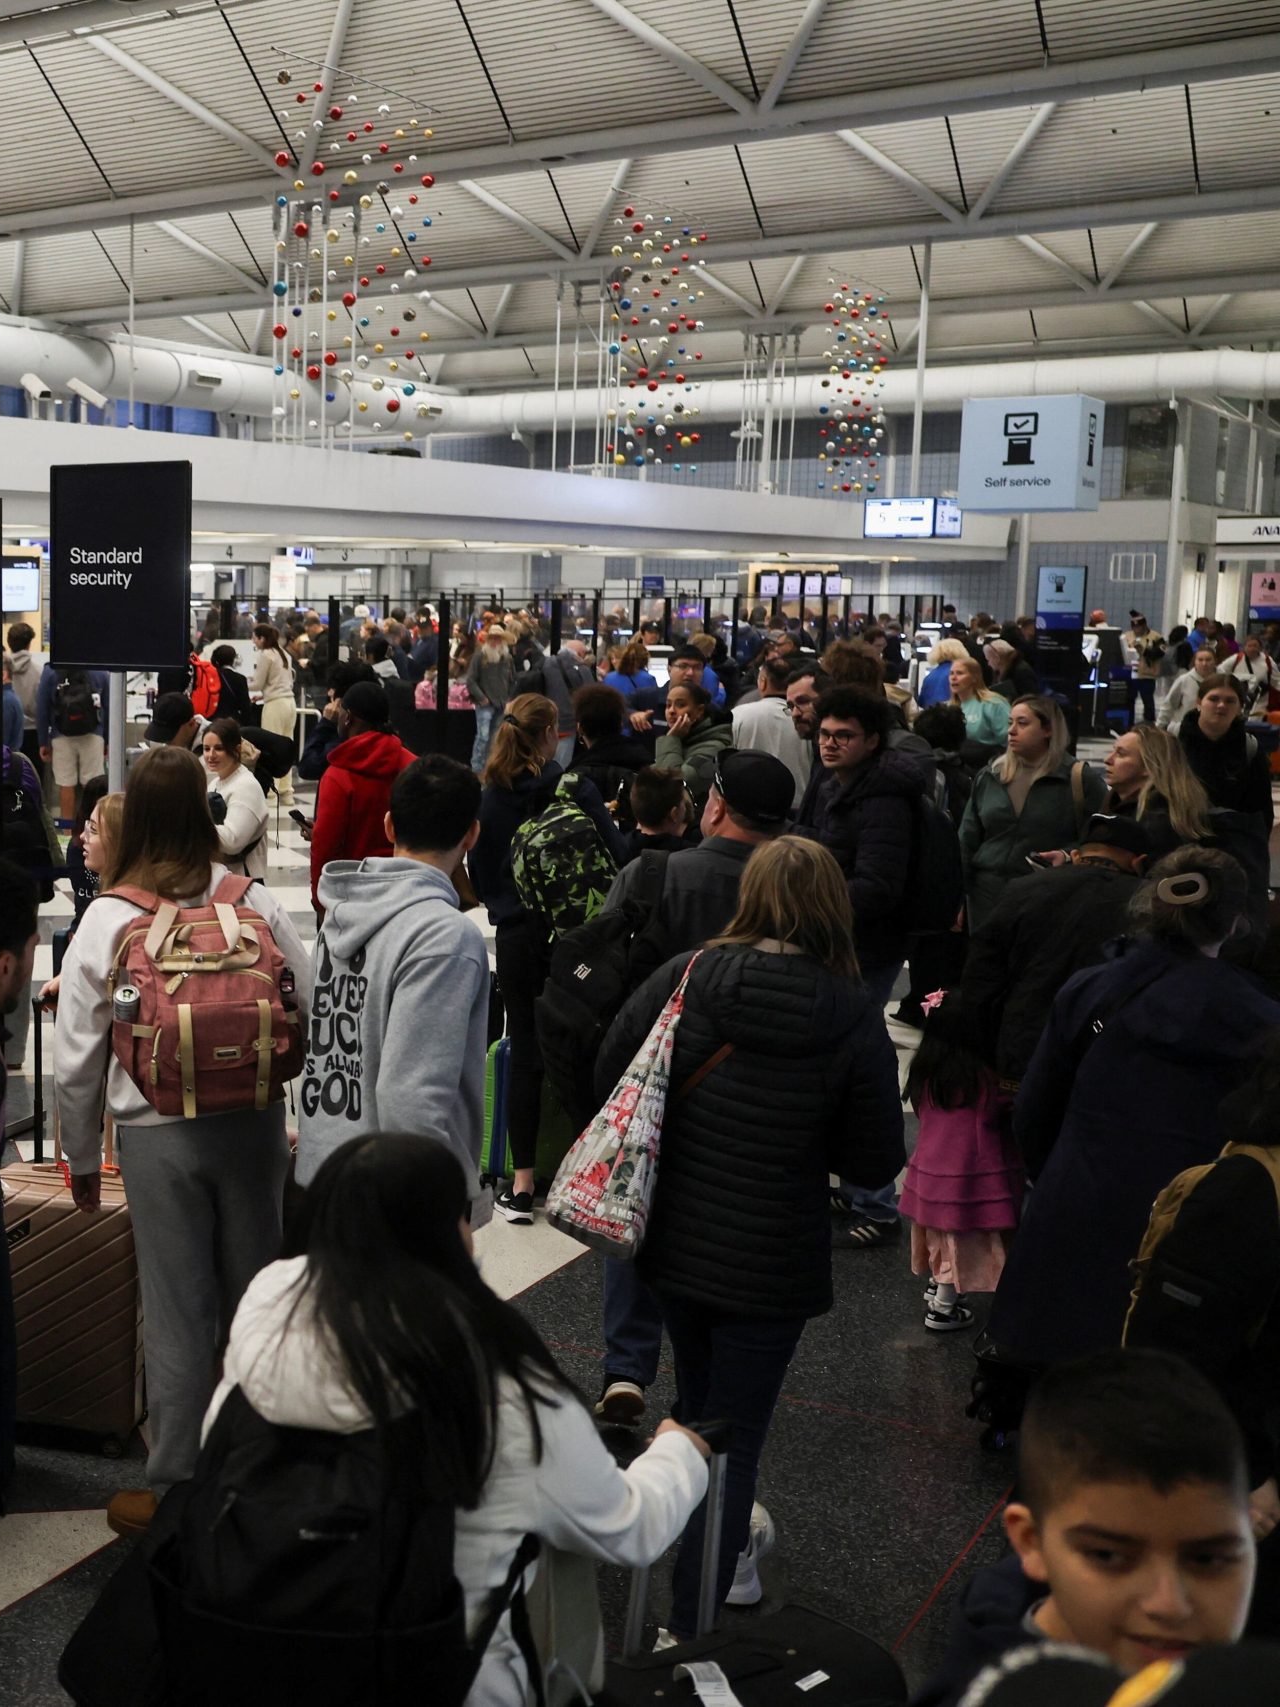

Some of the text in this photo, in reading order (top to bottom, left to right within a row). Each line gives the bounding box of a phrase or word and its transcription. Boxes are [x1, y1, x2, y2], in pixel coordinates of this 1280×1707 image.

[984, 476, 1051, 488] Self service
[69, 547, 143, 565] Standard
[69, 570, 132, 590] security
[301, 1071, 362, 1121] GOD
